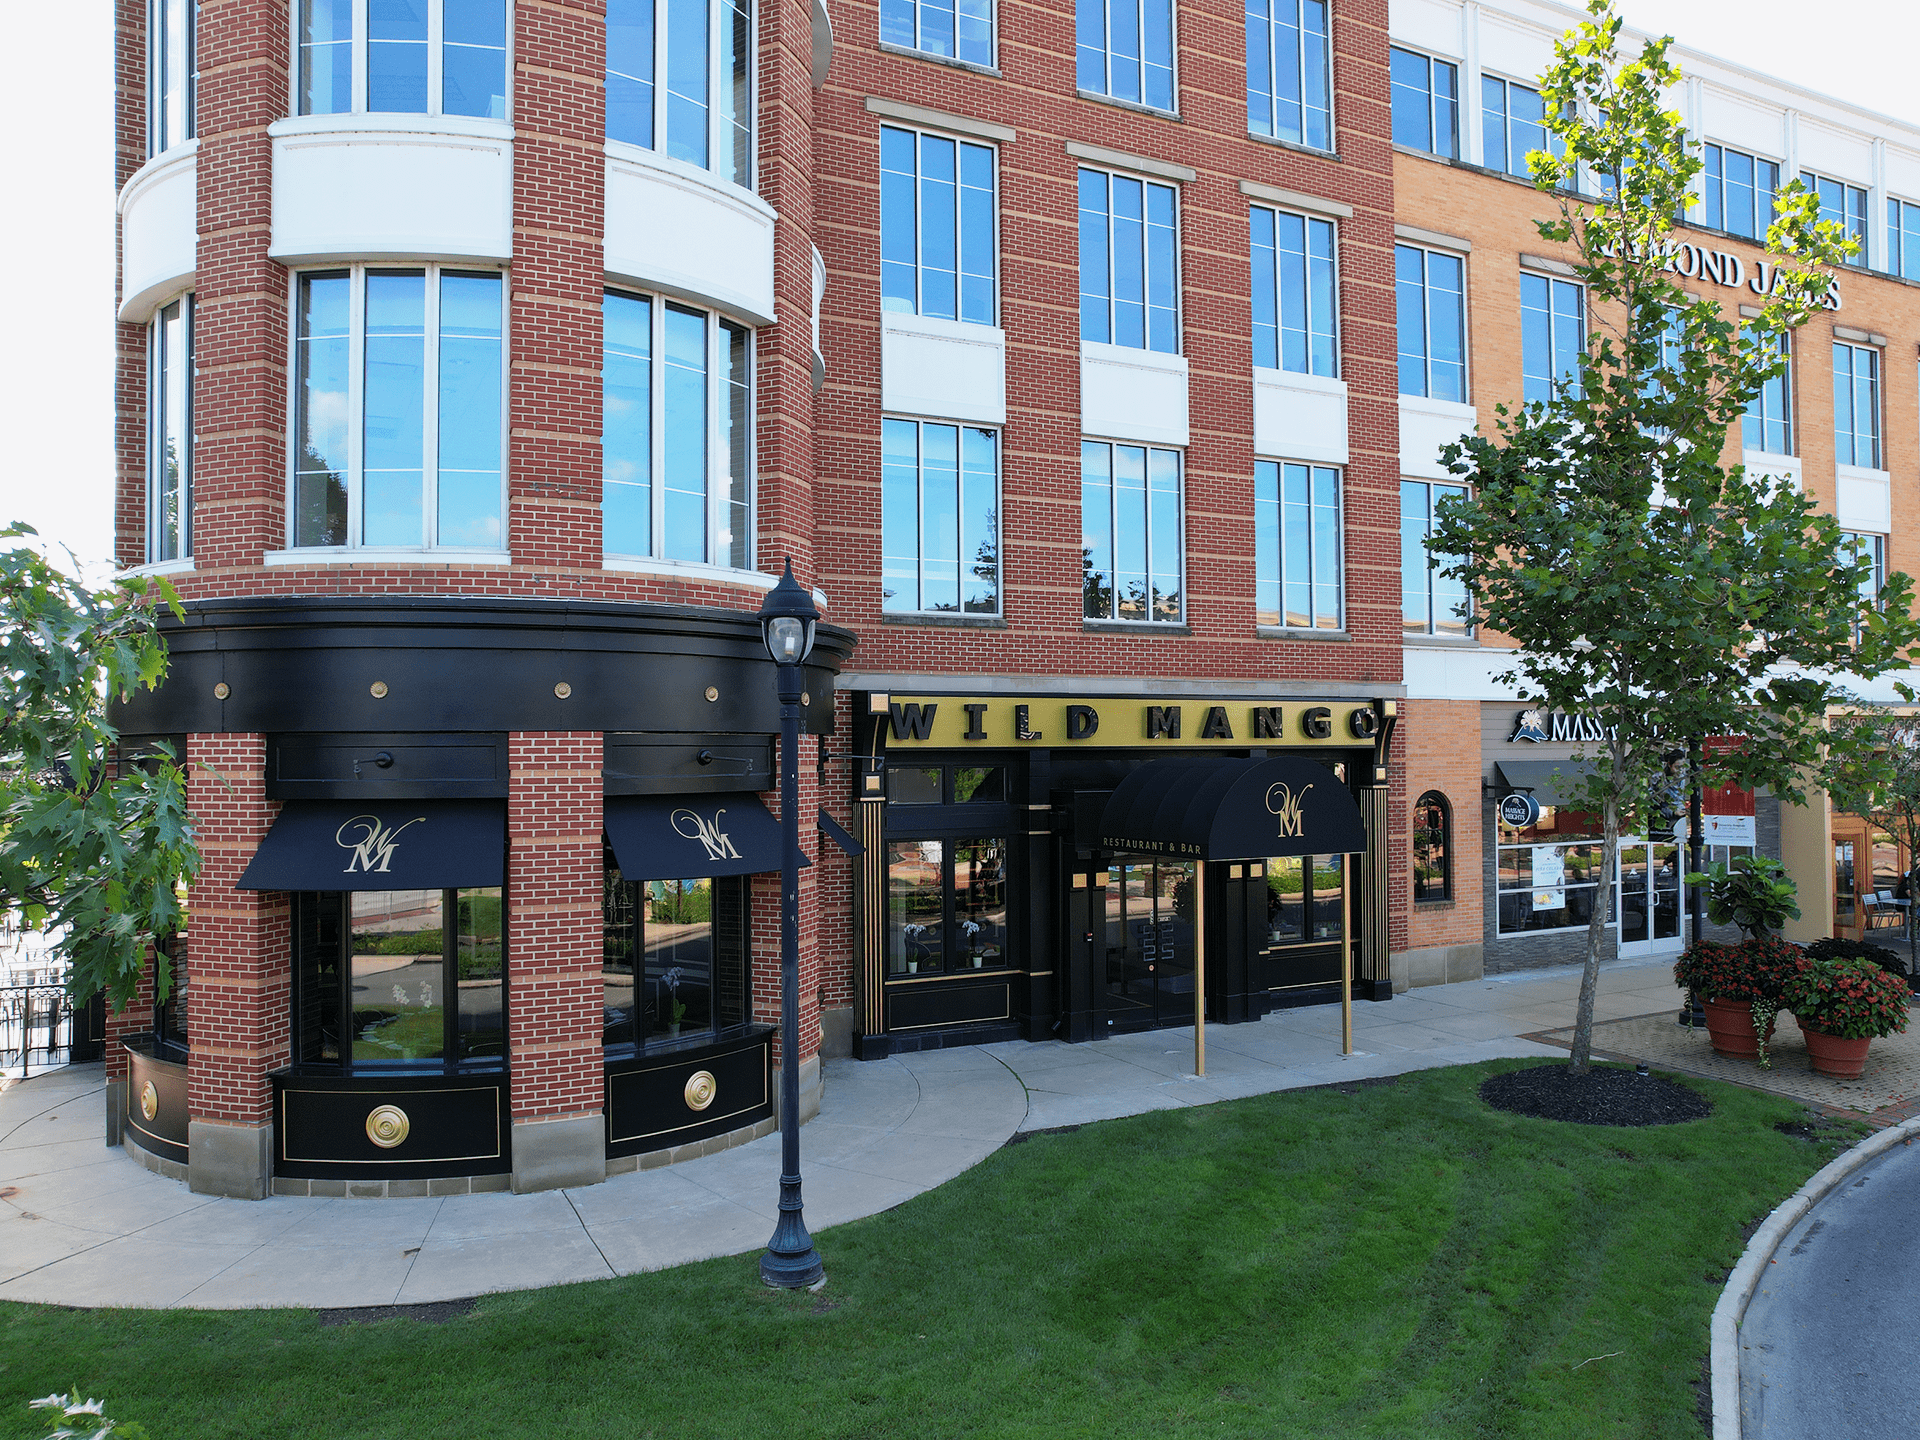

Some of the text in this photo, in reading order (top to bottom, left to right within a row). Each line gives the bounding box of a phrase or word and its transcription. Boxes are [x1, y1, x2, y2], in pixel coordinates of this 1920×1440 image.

[1584, 217, 1842, 311] YMOND JAS
[889, 703, 1380, 740] WILD MANGO
[1103, 837, 1201, 855] RESTAURANT & BAR
